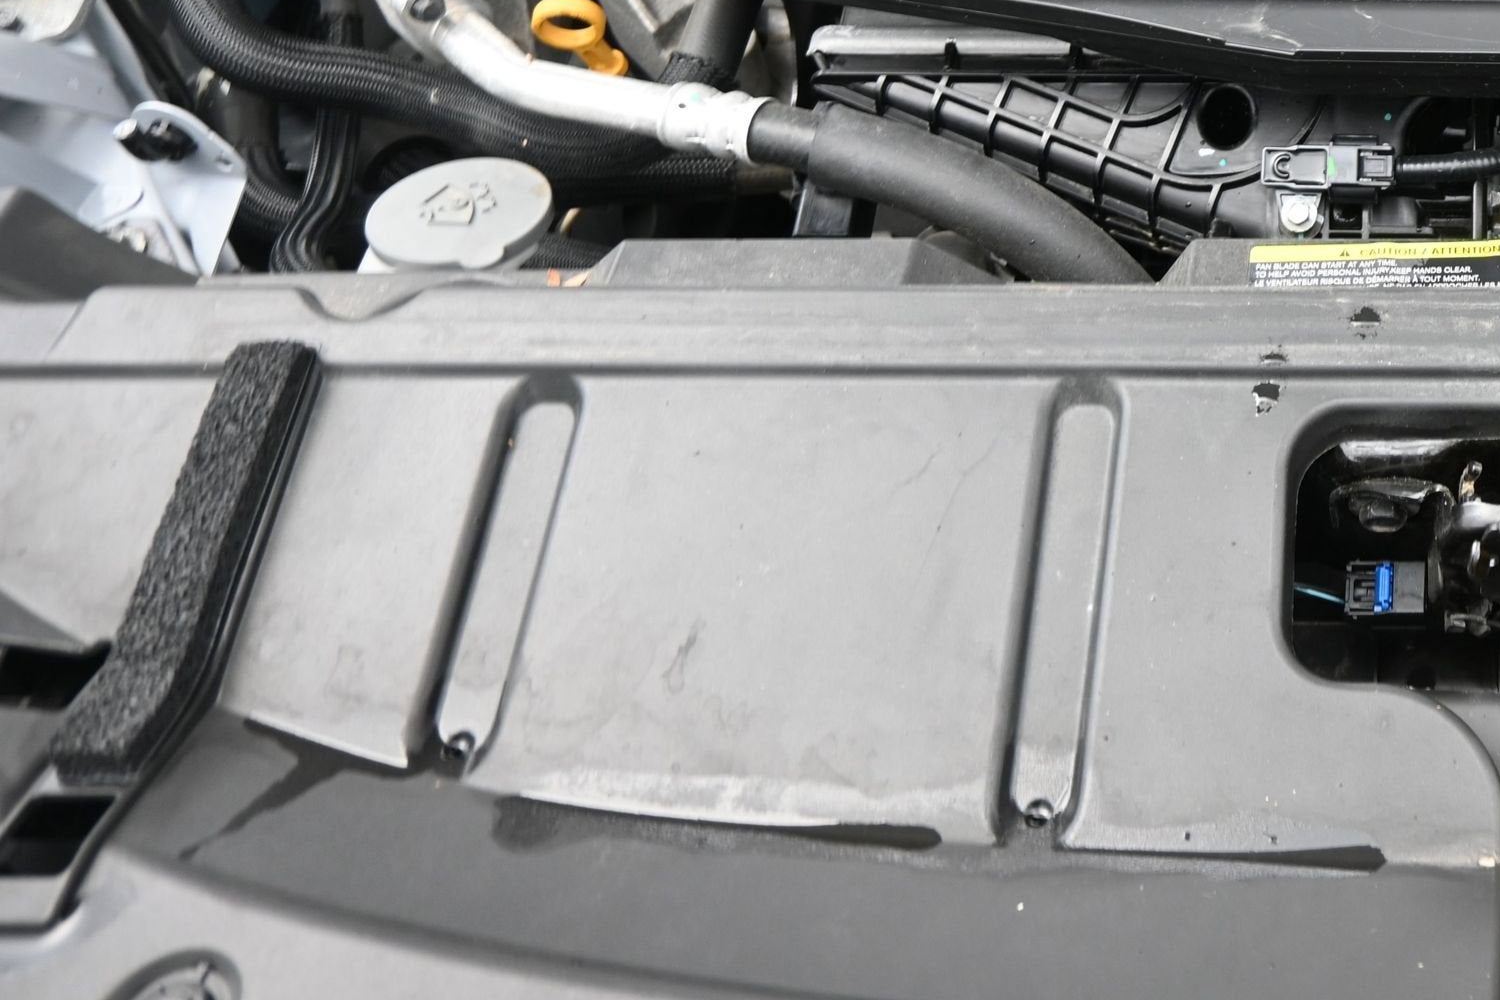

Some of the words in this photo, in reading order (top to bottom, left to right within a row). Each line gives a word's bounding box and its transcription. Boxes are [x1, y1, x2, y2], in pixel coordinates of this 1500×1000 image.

[1360, 248, 1417, 256] CAUTION
[1432, 245, 1500, 255] ATTENTION
[1301, 262, 1319, 270] CAN
[1321, 261, 1346, 269] START
[1347, 260, 1358, 269] AT
[1359, 260, 1376, 268] ANY
[1378, 259, 1398, 267] TIME.
[1255, 271, 1266, 279] TO
[1268, 270, 1290, 278] HELP
[1291, 269, 1316, 277] AVOID
[1317, 268, 1362, 277] PERSONAL
[1413, 266, 1442, 274] HANDS
[1443, 265, 1473, 273] CLEAR.
[1254, 279, 1264, 288] LE
[1266, 278, 1319, 287] VENTILATEUR
[1320, 277, 1352, 286] RISQUE
[1353, 276, 1364, 285] DE
[1420, 275, 1442, 283] TOUT
[1443, 274, 1480, 282] MOMENT.
